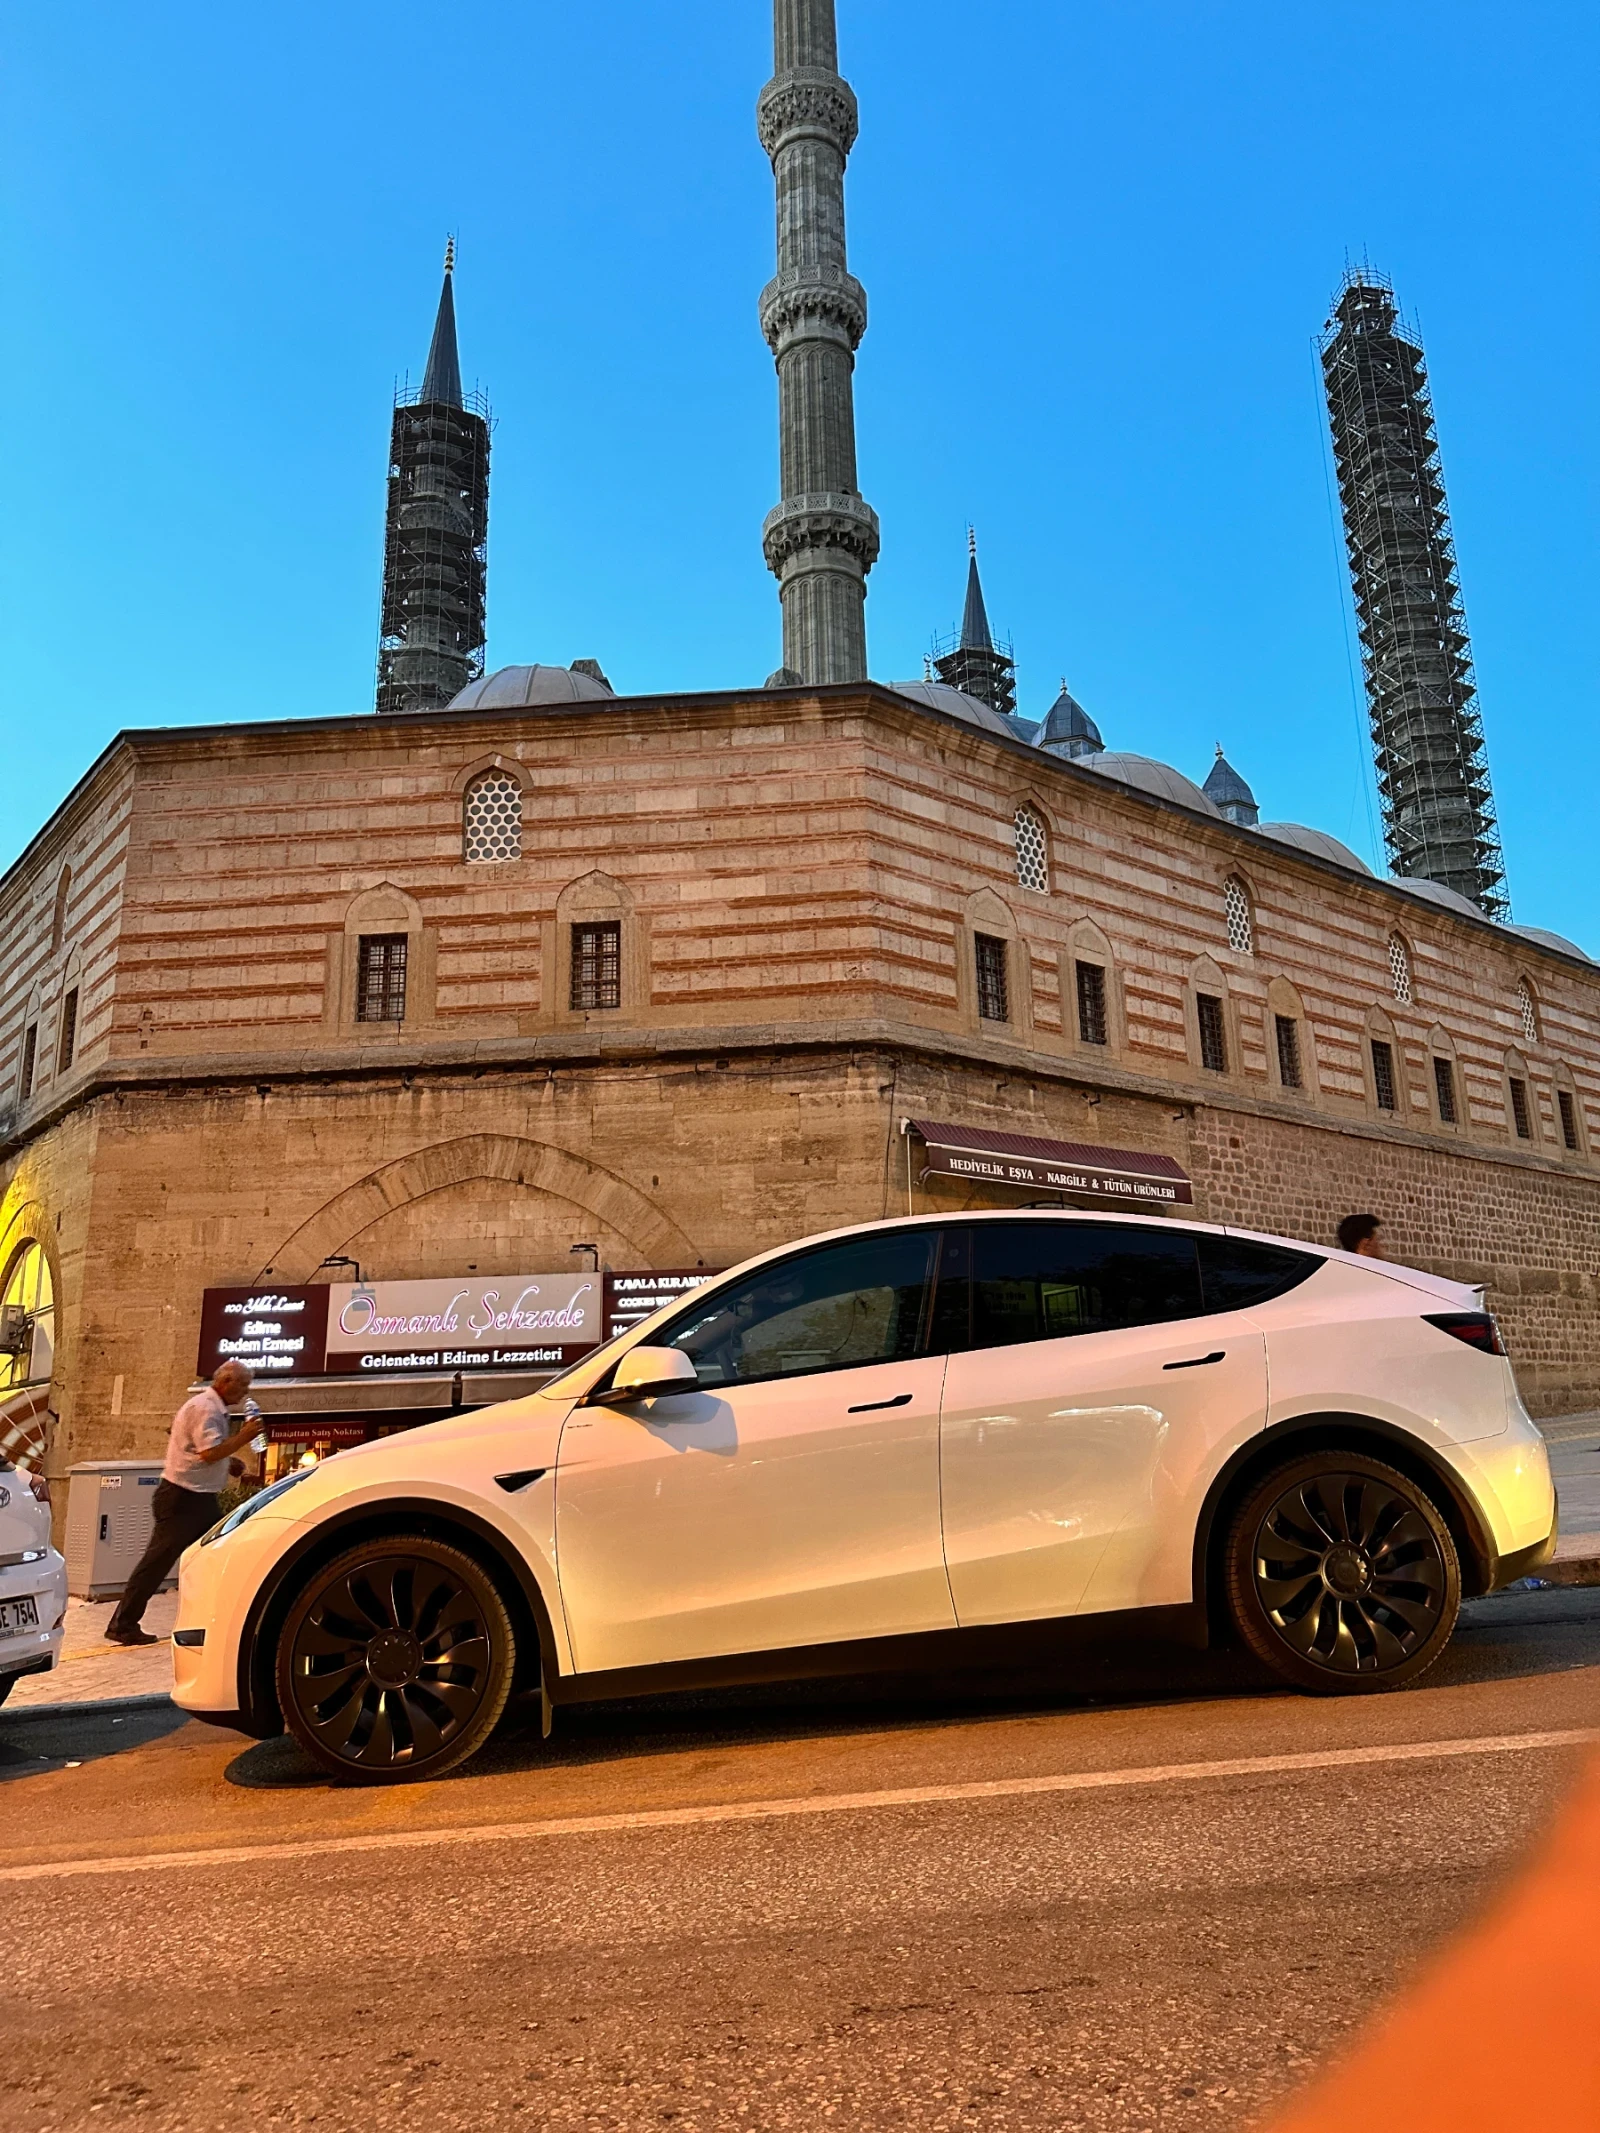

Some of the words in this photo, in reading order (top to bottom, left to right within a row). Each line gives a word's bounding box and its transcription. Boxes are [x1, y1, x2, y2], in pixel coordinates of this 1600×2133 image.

[950, 1158, 1004, 1176] HEDİYELİK
[1009, 1167, 1034, 1180] EŞYA
[1047, 1172, 1087, 1188] NARGİLE
[1091, 1178, 1099, 1189] &
[1103, 1179, 1132, 1194] TÜTÜN
[1133, 1181, 1175, 1199] ÜRÜNLERİ
[613, 1278, 657, 1290] KAVALA
[224, 1303, 242, 1313] 100
[338, 1289, 470, 1335] Osmanlı
[467, 1283, 591, 1339] Şehzade
[243, 1320, 281, 1335] Edirne
[219, 1338, 260, 1352] Badem
[262, 1336, 304, 1350] Ezmesi
[360, 1351, 439, 1368] Geleneksel
[442, 1349, 489, 1365] Edirne
[492, 1347, 563, 1363] Lezzetleri
[333, 1427, 363, 1436] Noktası
[12, 1601, 35, 1626] 754
